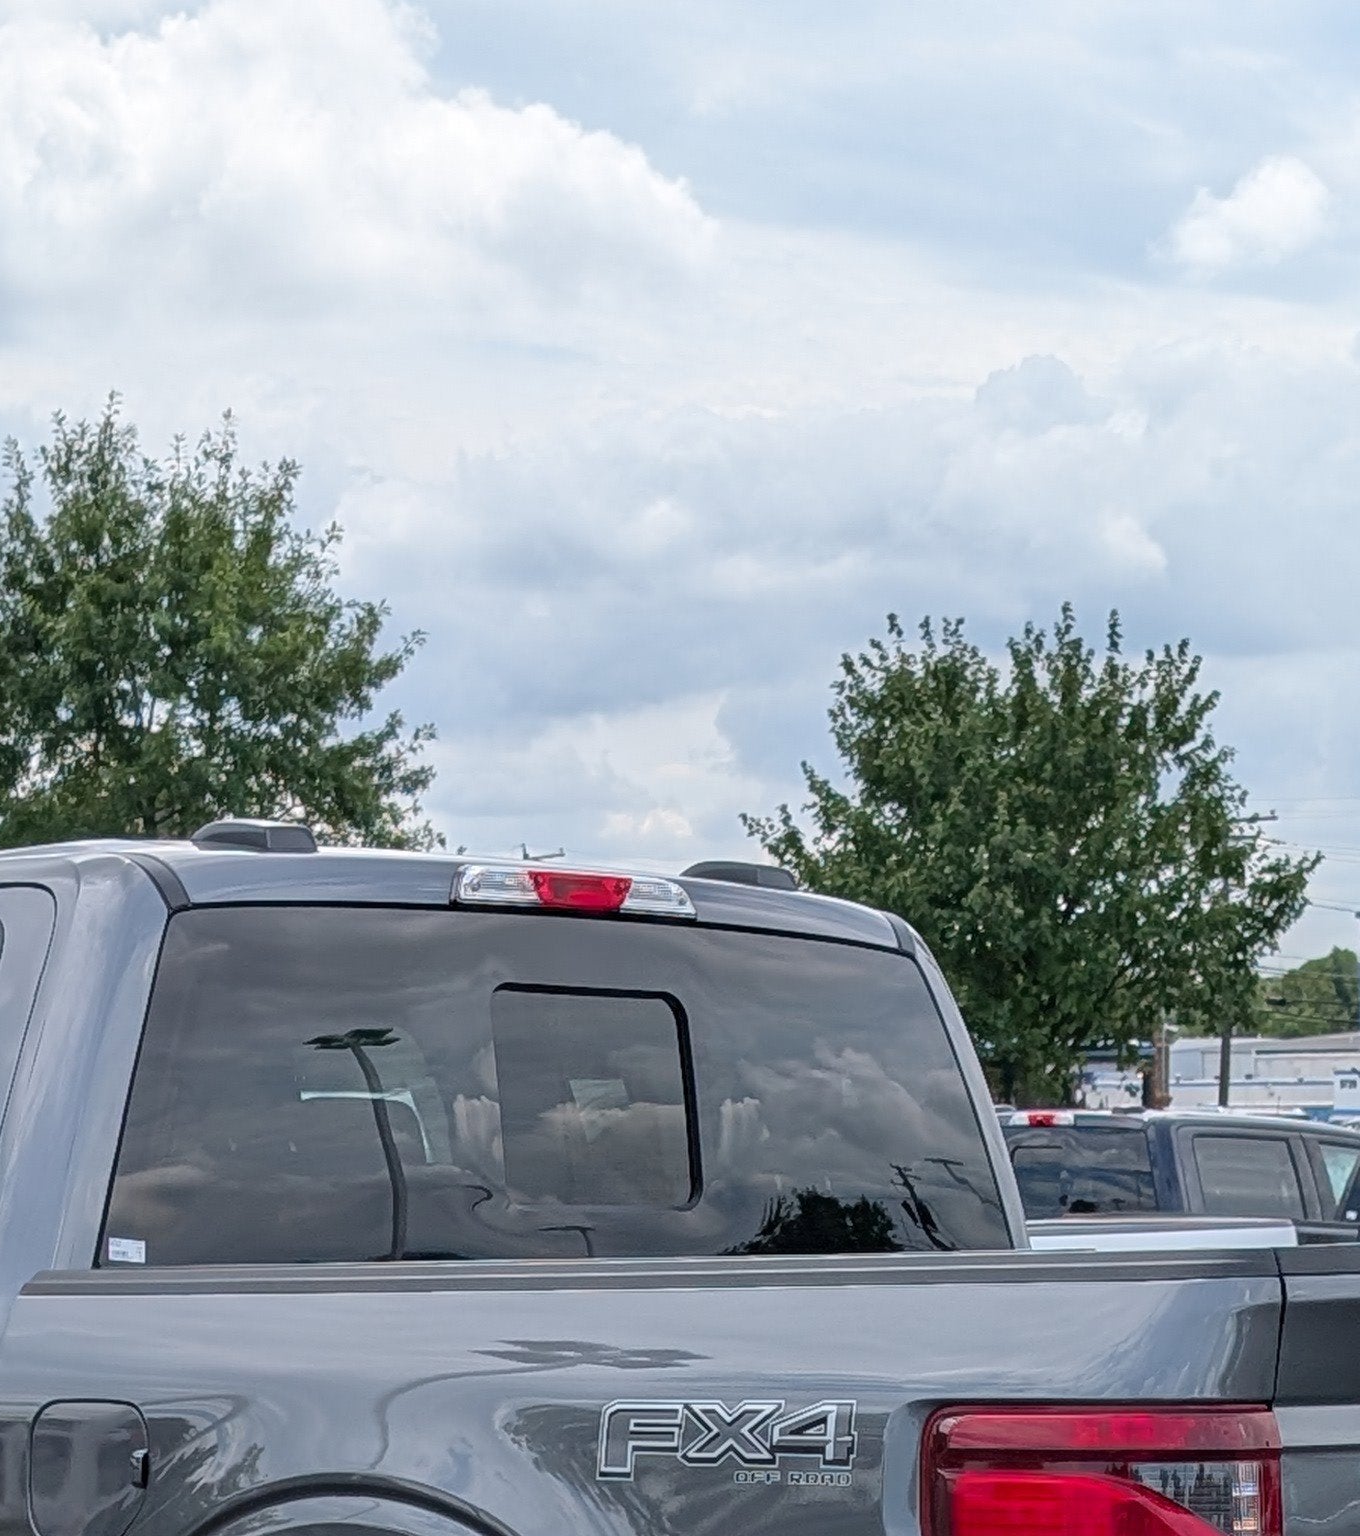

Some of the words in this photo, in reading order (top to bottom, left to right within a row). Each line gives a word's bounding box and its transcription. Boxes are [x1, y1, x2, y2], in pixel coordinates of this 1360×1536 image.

[596, 1398, 857, 1482] FX4
[734, 1469, 781, 1485] OFF
[787, 1471, 852, 1487] ROAD
